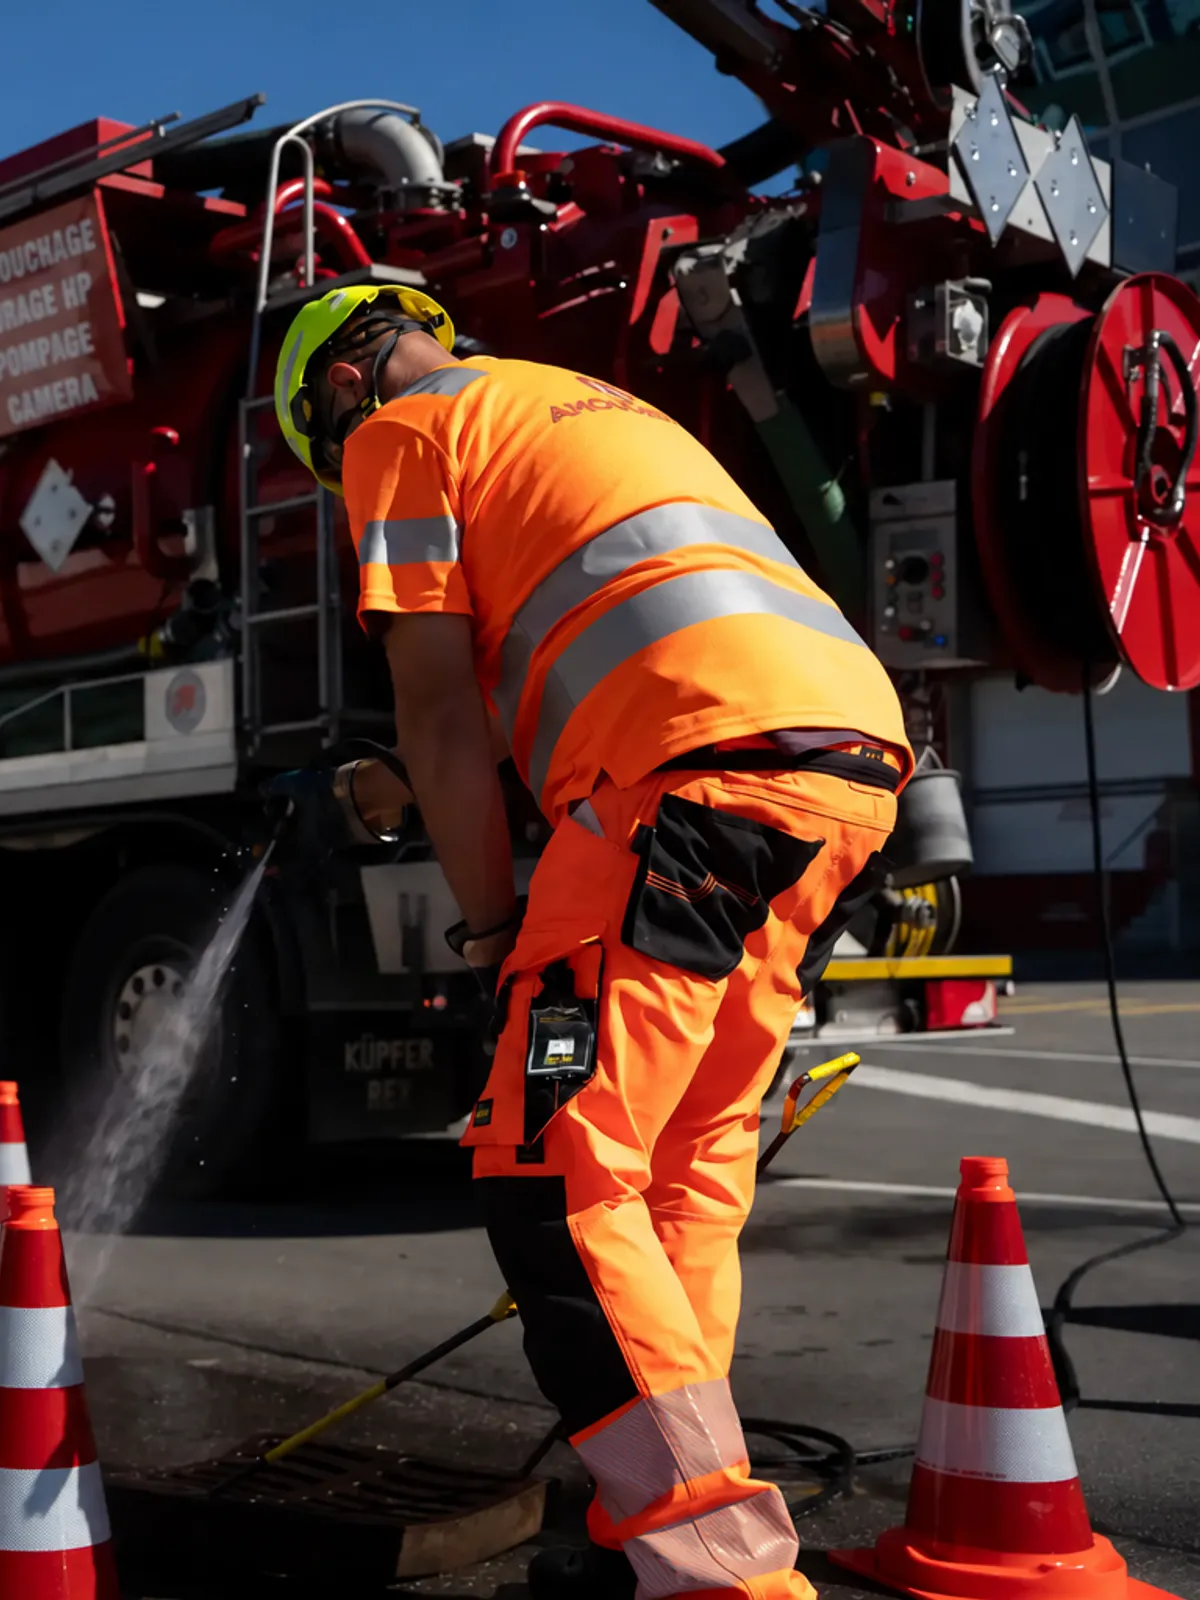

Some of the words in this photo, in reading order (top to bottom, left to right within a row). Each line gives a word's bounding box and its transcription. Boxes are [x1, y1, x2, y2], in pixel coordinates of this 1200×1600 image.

[61, 272, 93, 310] HP
[6, 372, 98, 425] CAMERA
[344, 1032, 435, 1073] KÜPFER
